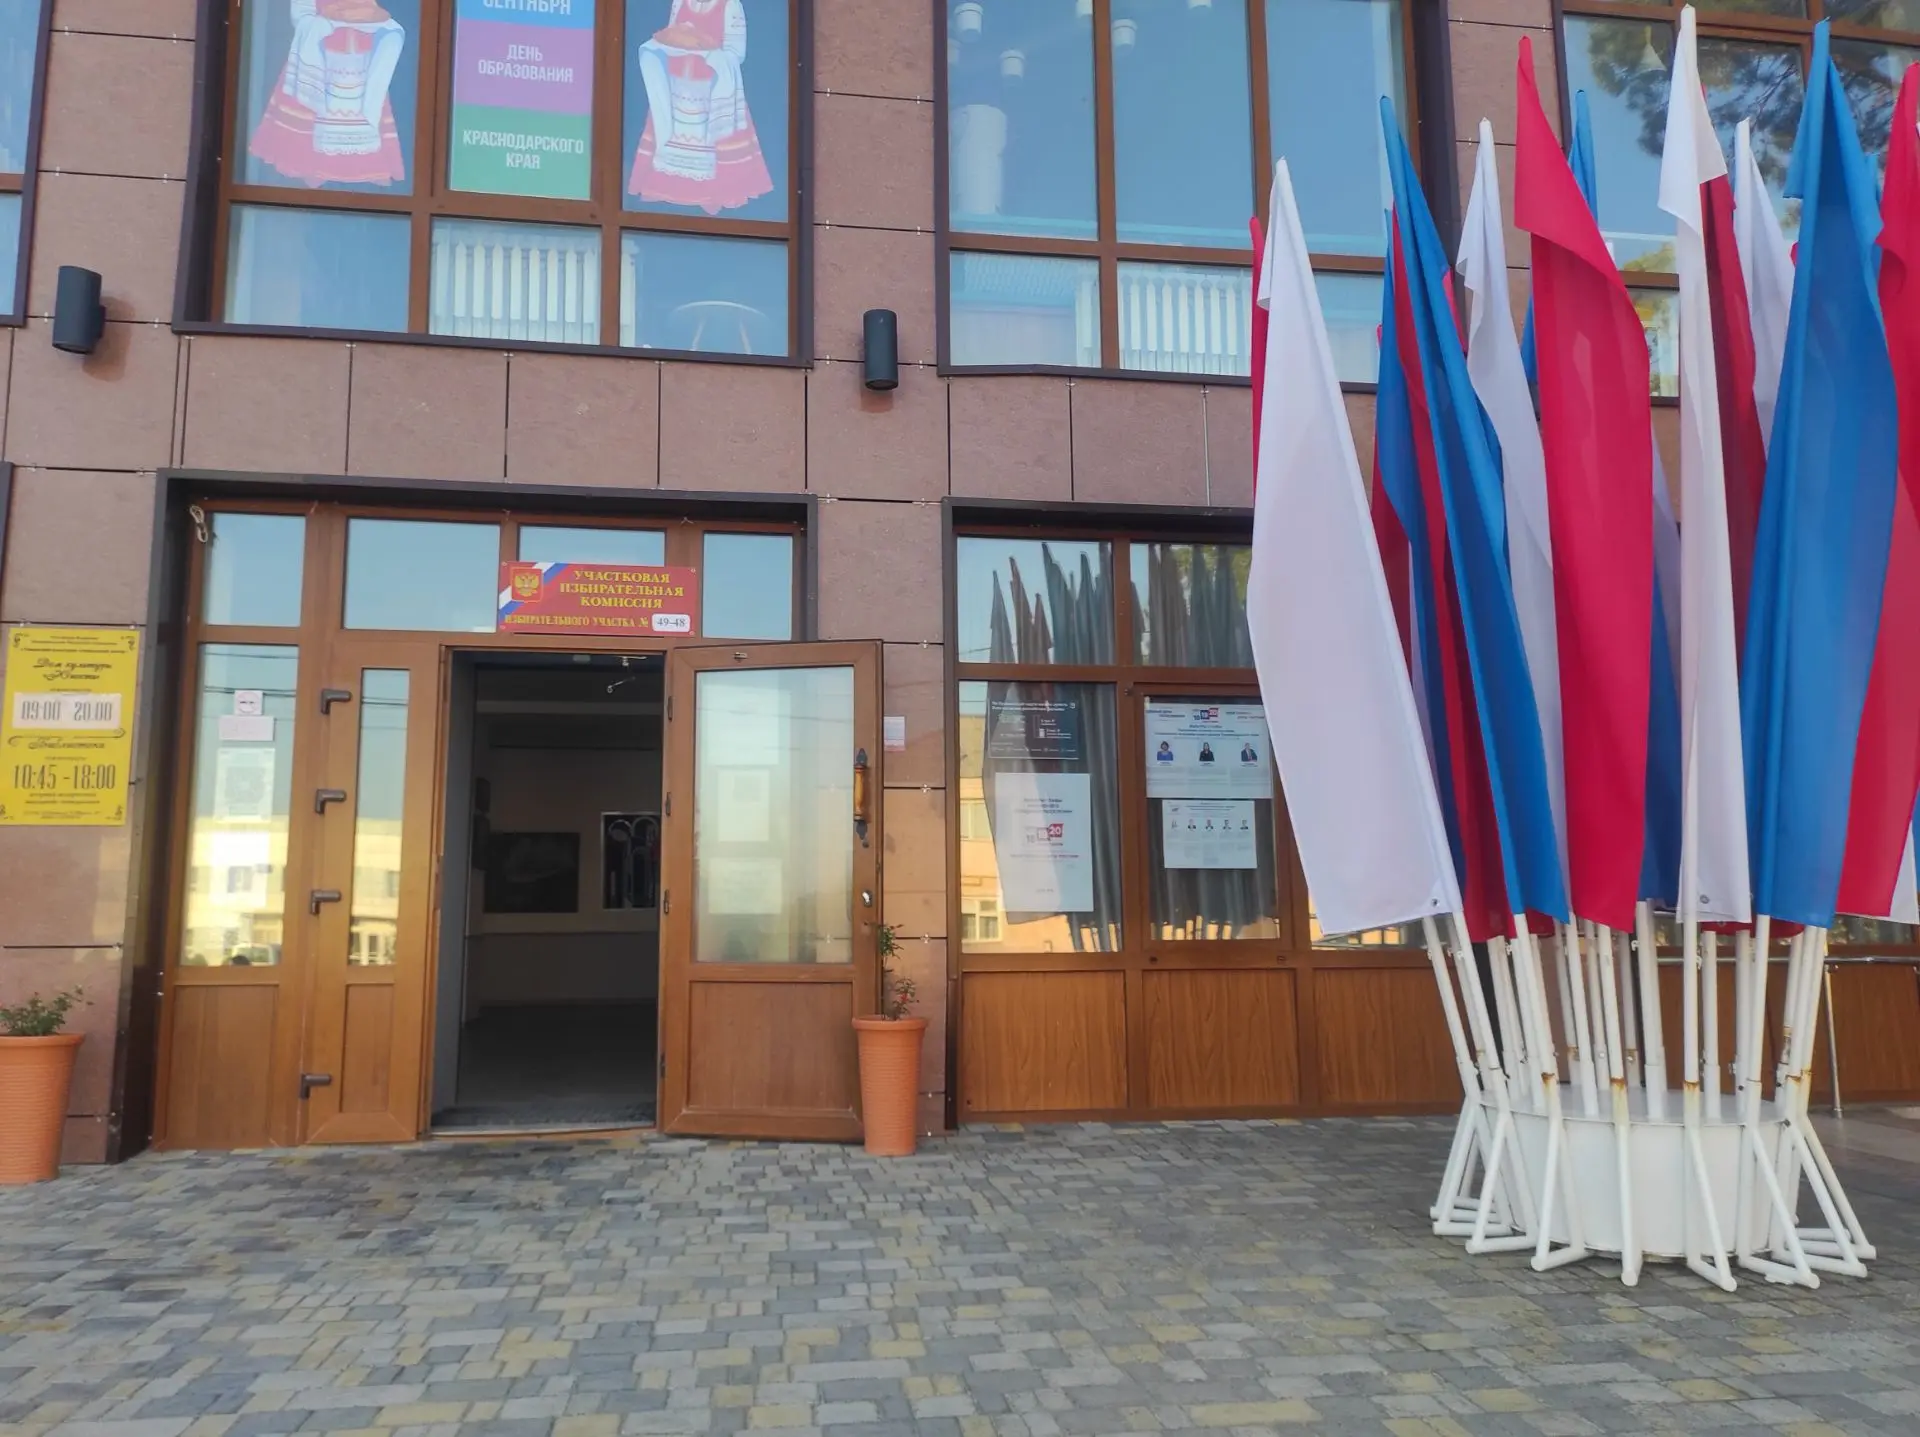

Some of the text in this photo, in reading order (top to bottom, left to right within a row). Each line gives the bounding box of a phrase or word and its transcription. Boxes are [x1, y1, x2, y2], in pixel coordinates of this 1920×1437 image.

[507, 44, 543, 62] ДЕНЬ
[478, 59, 573, 83] ОБРАЗОВАНИЯ
[463, 130, 584, 154] КРАСНОДАРСКОГО
[506, 152, 541, 169] КРАЯ
[574, 570, 670, 583] УЧАСТКОВАЯ
[560, 583, 684, 597] ИЗБИРАТЕЛЬНАЯ
[580, 596, 663, 609] КОМИССИЯ
[1049, 826, 1061, 835] 20
